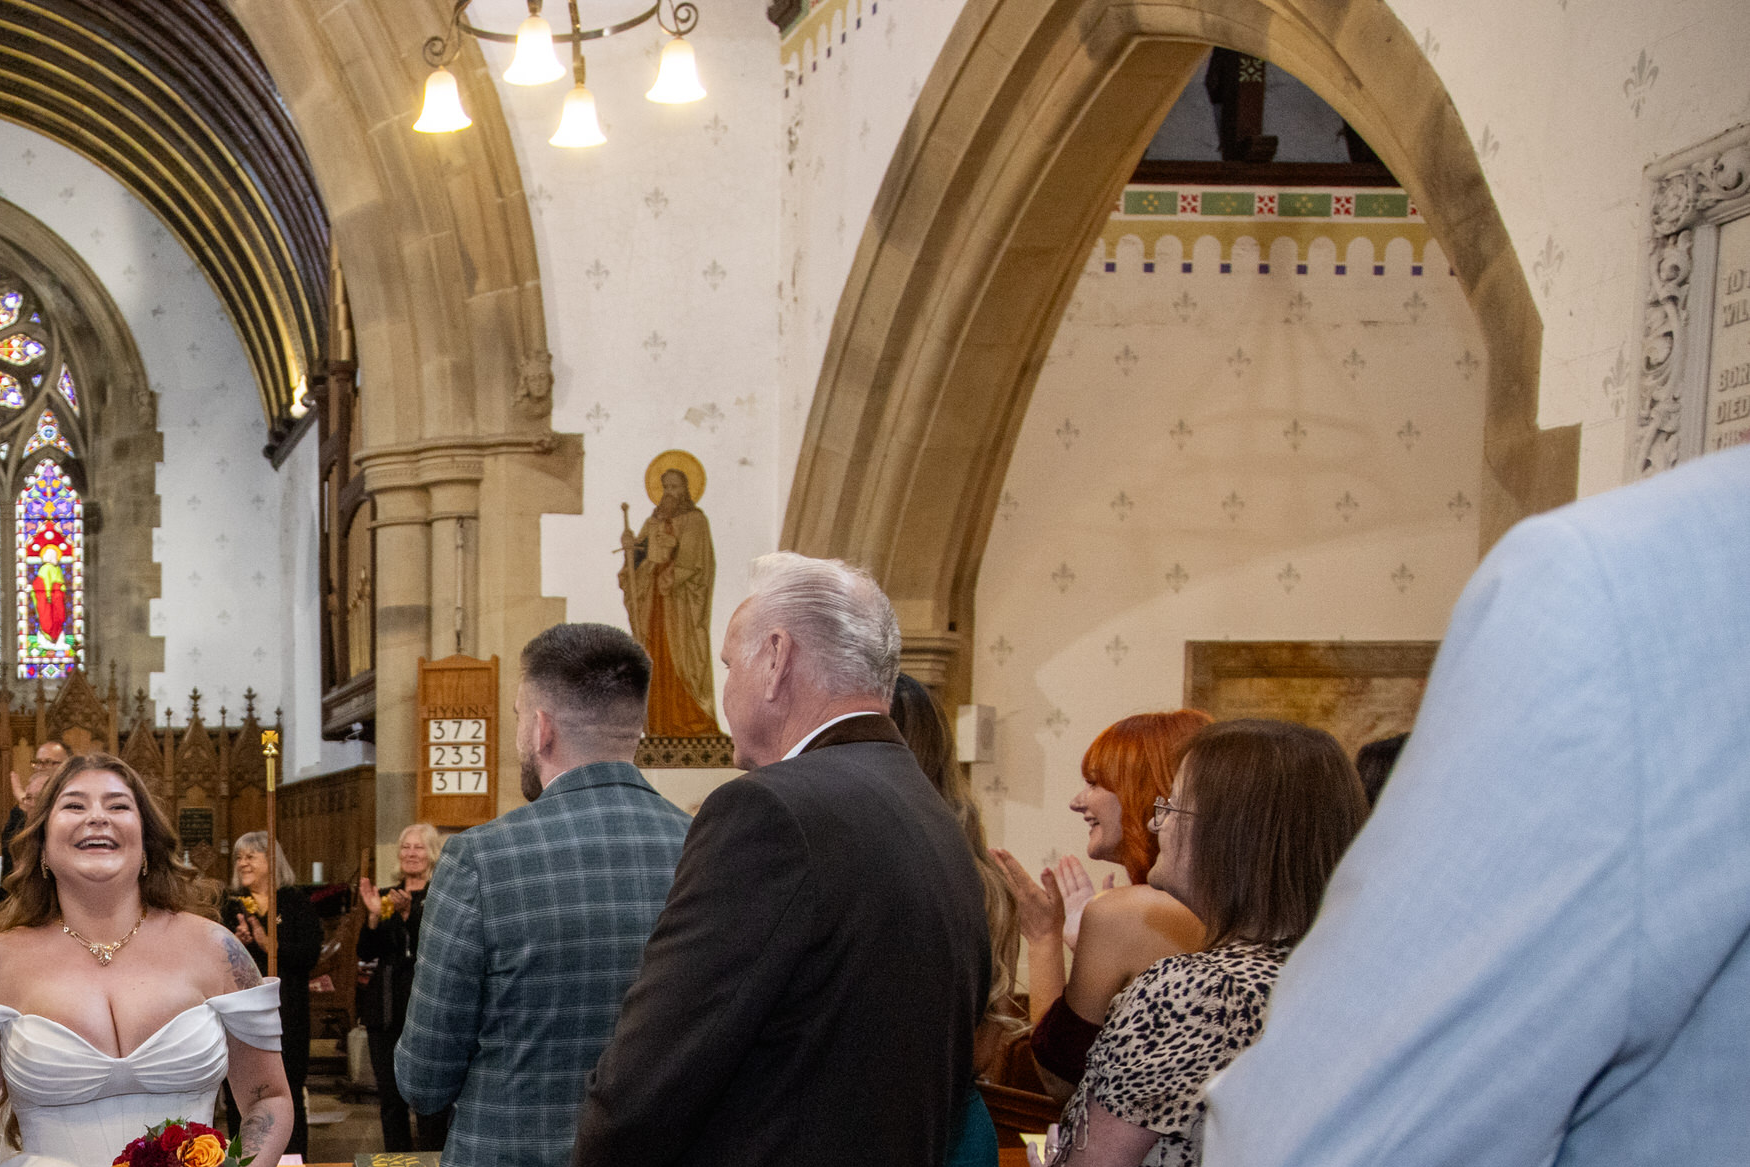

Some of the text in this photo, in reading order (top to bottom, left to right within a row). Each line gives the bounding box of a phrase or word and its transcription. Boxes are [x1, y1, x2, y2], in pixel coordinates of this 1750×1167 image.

[426, 704, 489, 718] HYMNS
[433, 720, 483, 740] 372
[433, 746, 482, 766] 235
[435, 772, 483, 792] 317
